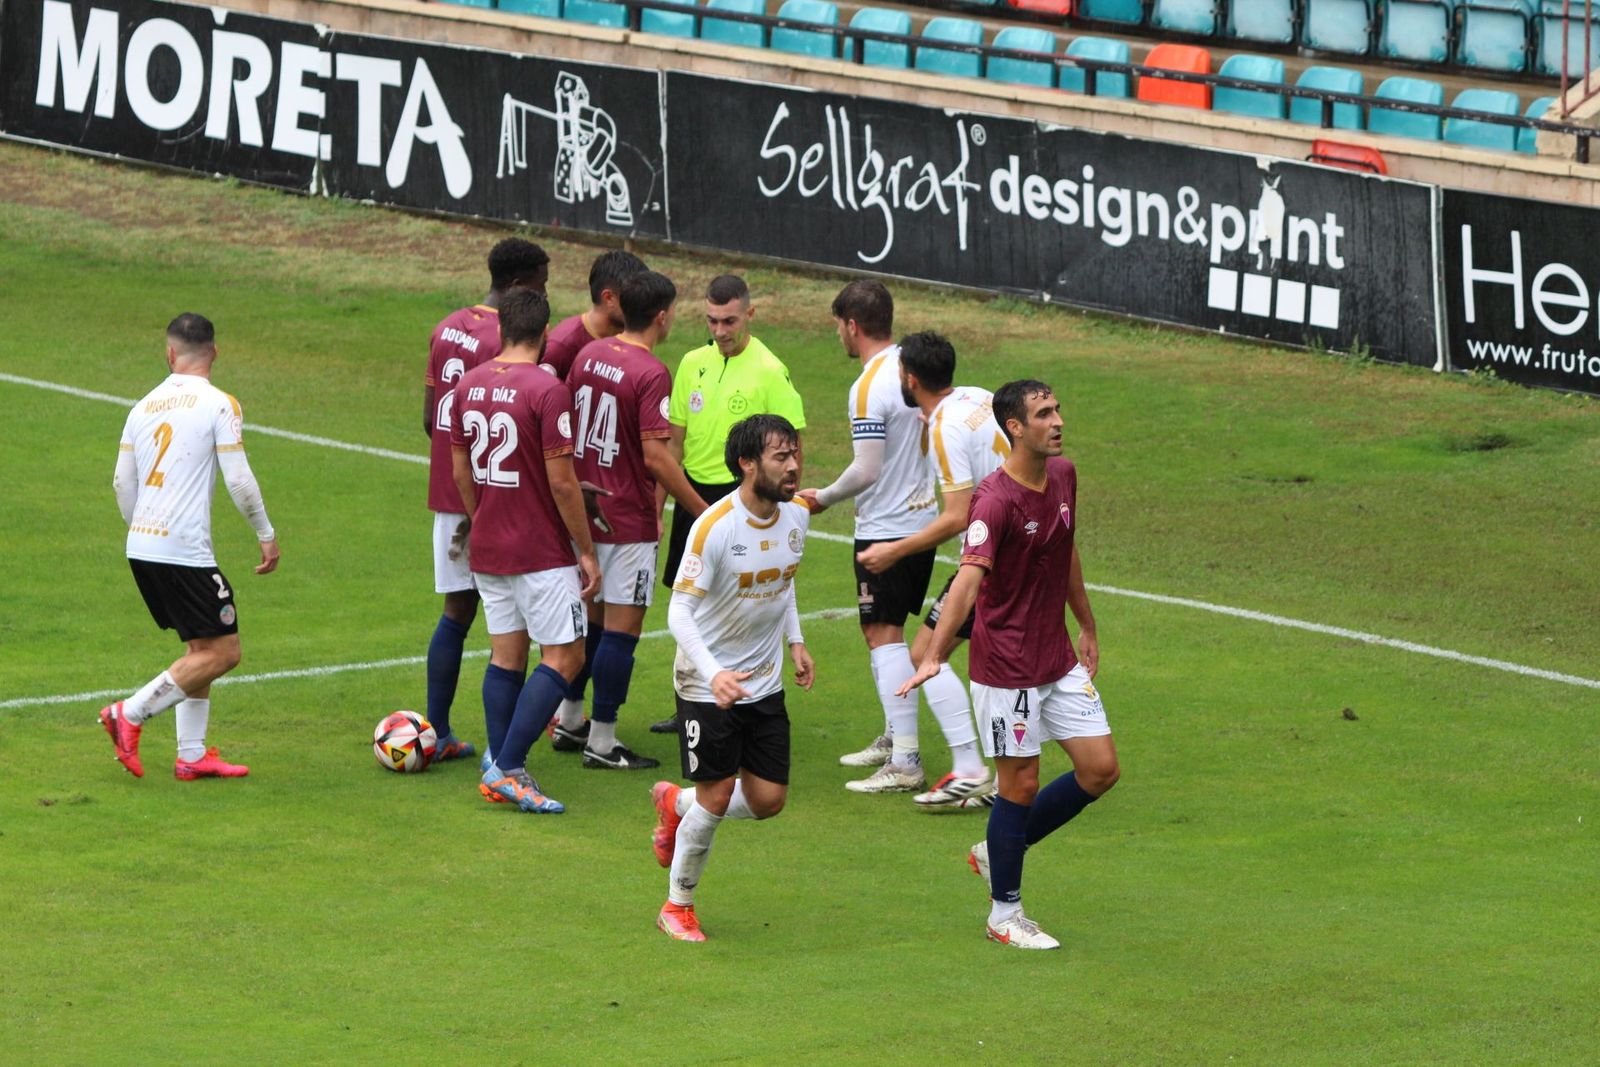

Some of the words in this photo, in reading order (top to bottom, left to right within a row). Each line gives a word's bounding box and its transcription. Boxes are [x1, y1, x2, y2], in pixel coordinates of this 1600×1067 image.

[35, 0, 473, 199] MORETA
[1461, 223, 1600, 336] He
[492, 386, 517, 404] DÍAZ
[574, 384, 620, 468] 14
[144, 421, 174, 488] 2
[462, 409, 520, 488] 22
[212, 573, 230, 600] 2
[1012, 689, 1030, 720] 4
